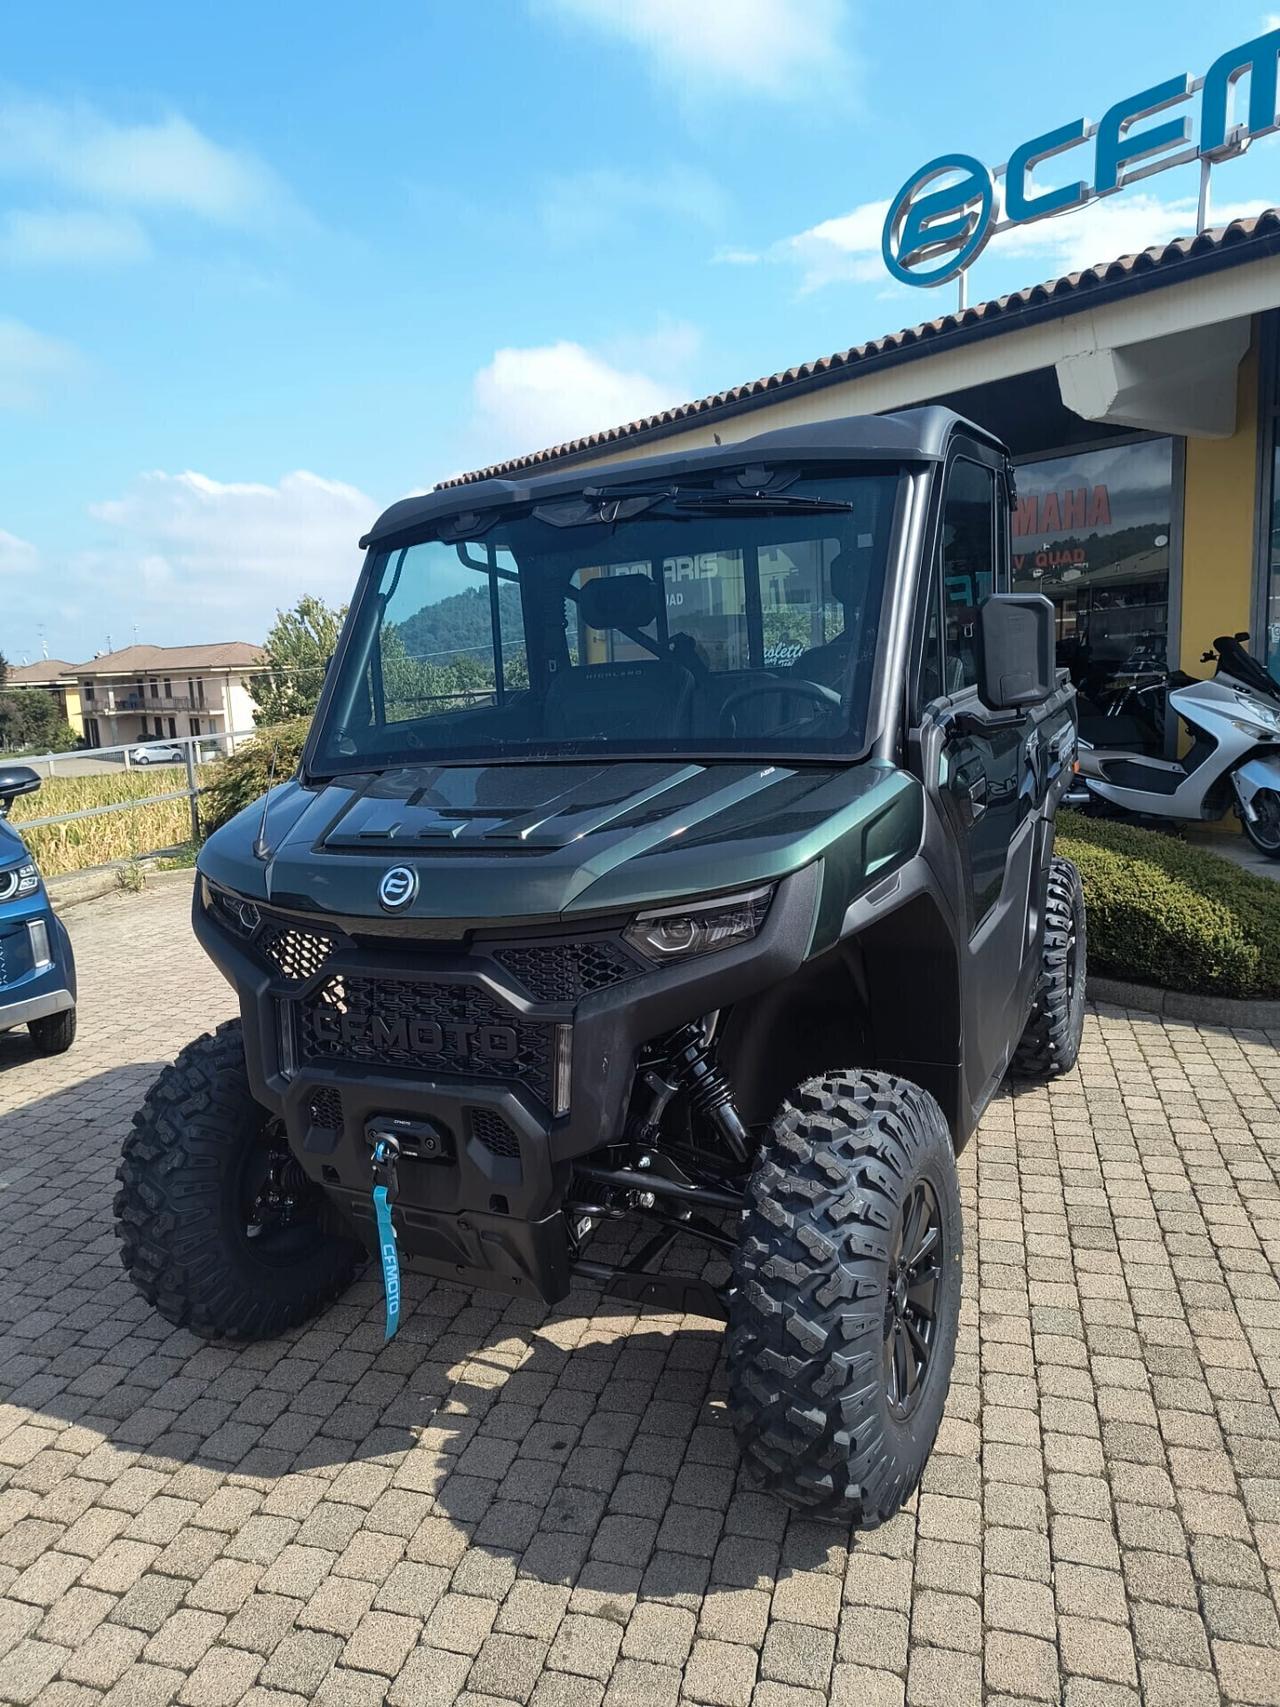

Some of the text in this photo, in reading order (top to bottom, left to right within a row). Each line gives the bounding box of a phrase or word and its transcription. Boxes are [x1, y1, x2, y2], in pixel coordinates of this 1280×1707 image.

[1035, 547, 1086, 569] QUAD
[313, 1008, 519, 1061] CFMOTO
[382, 1243, 399, 1315] CFMOTO
